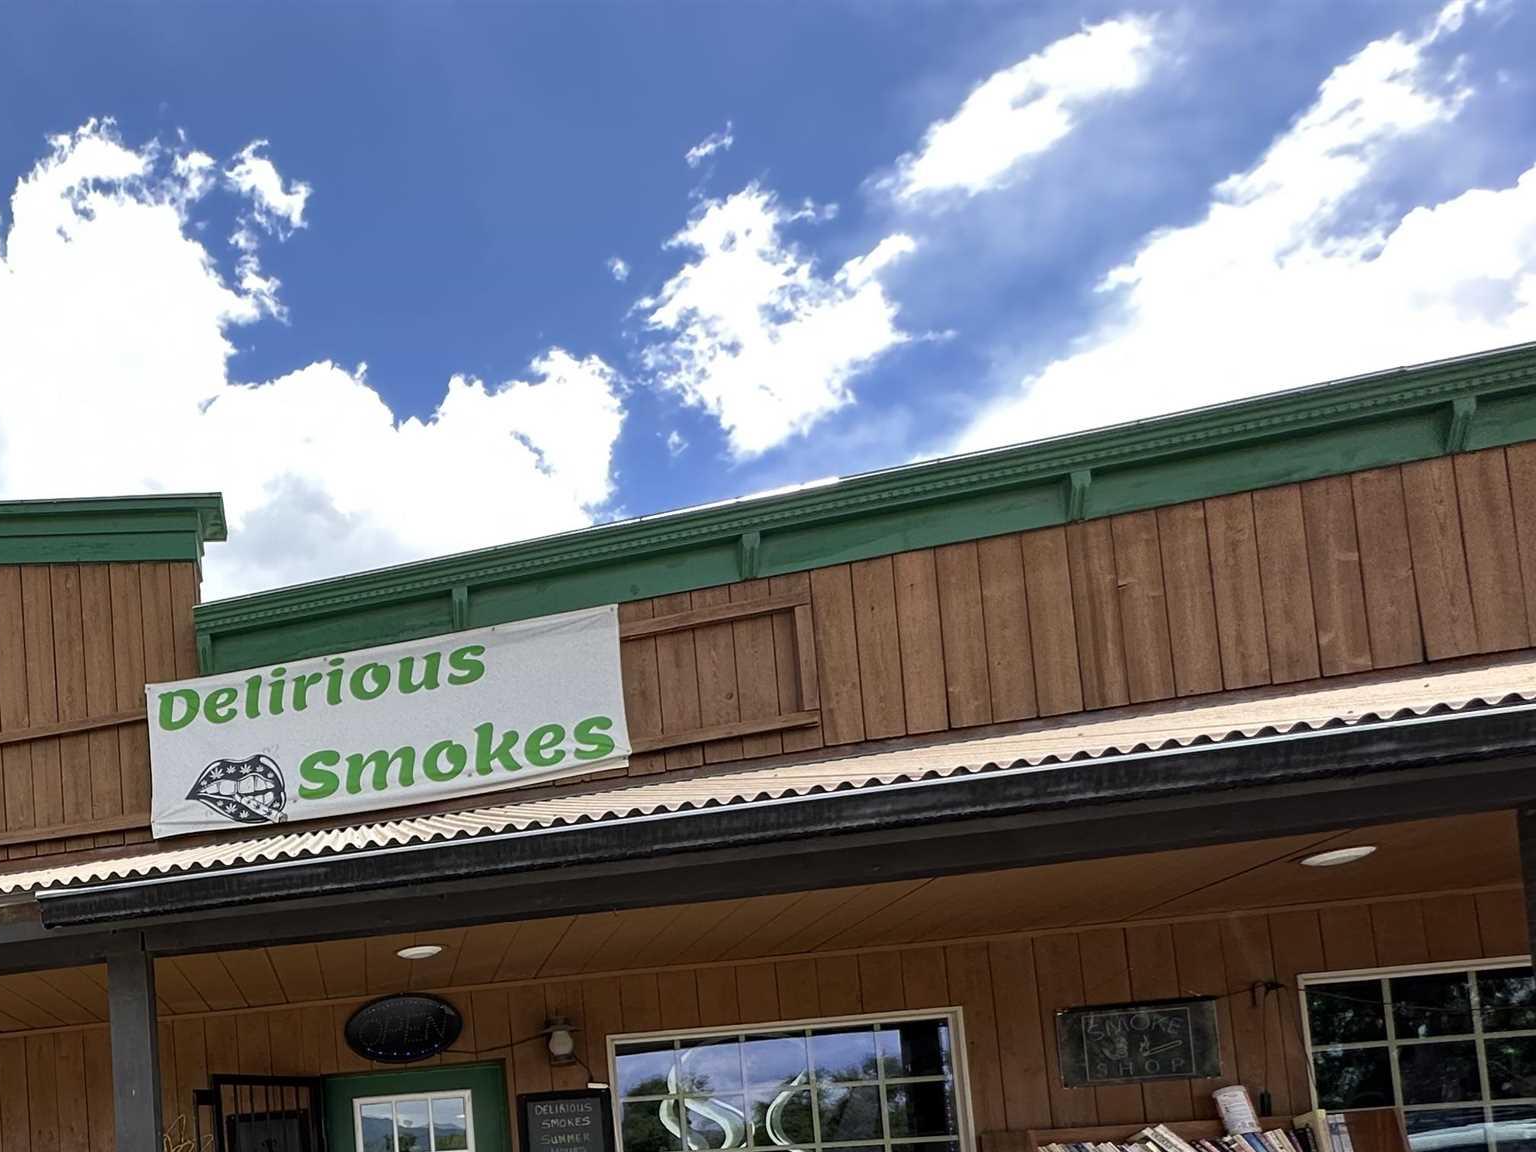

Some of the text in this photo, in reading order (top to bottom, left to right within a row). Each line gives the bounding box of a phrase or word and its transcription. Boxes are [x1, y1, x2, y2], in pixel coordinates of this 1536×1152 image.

[157, 643, 487, 731] Delirious
[297, 715, 617, 801] Smokes
[359, 1011, 448, 1047] OPEN
[1087, 1012, 1185, 1042] SMOKE
[1096, 1057, 1185, 1078] SHOP
[535, 1103, 592, 1116] DELIRIOUS
[542, 1117, 592, 1129] SMOKES
[541, 1133, 590, 1145] SUMMER
